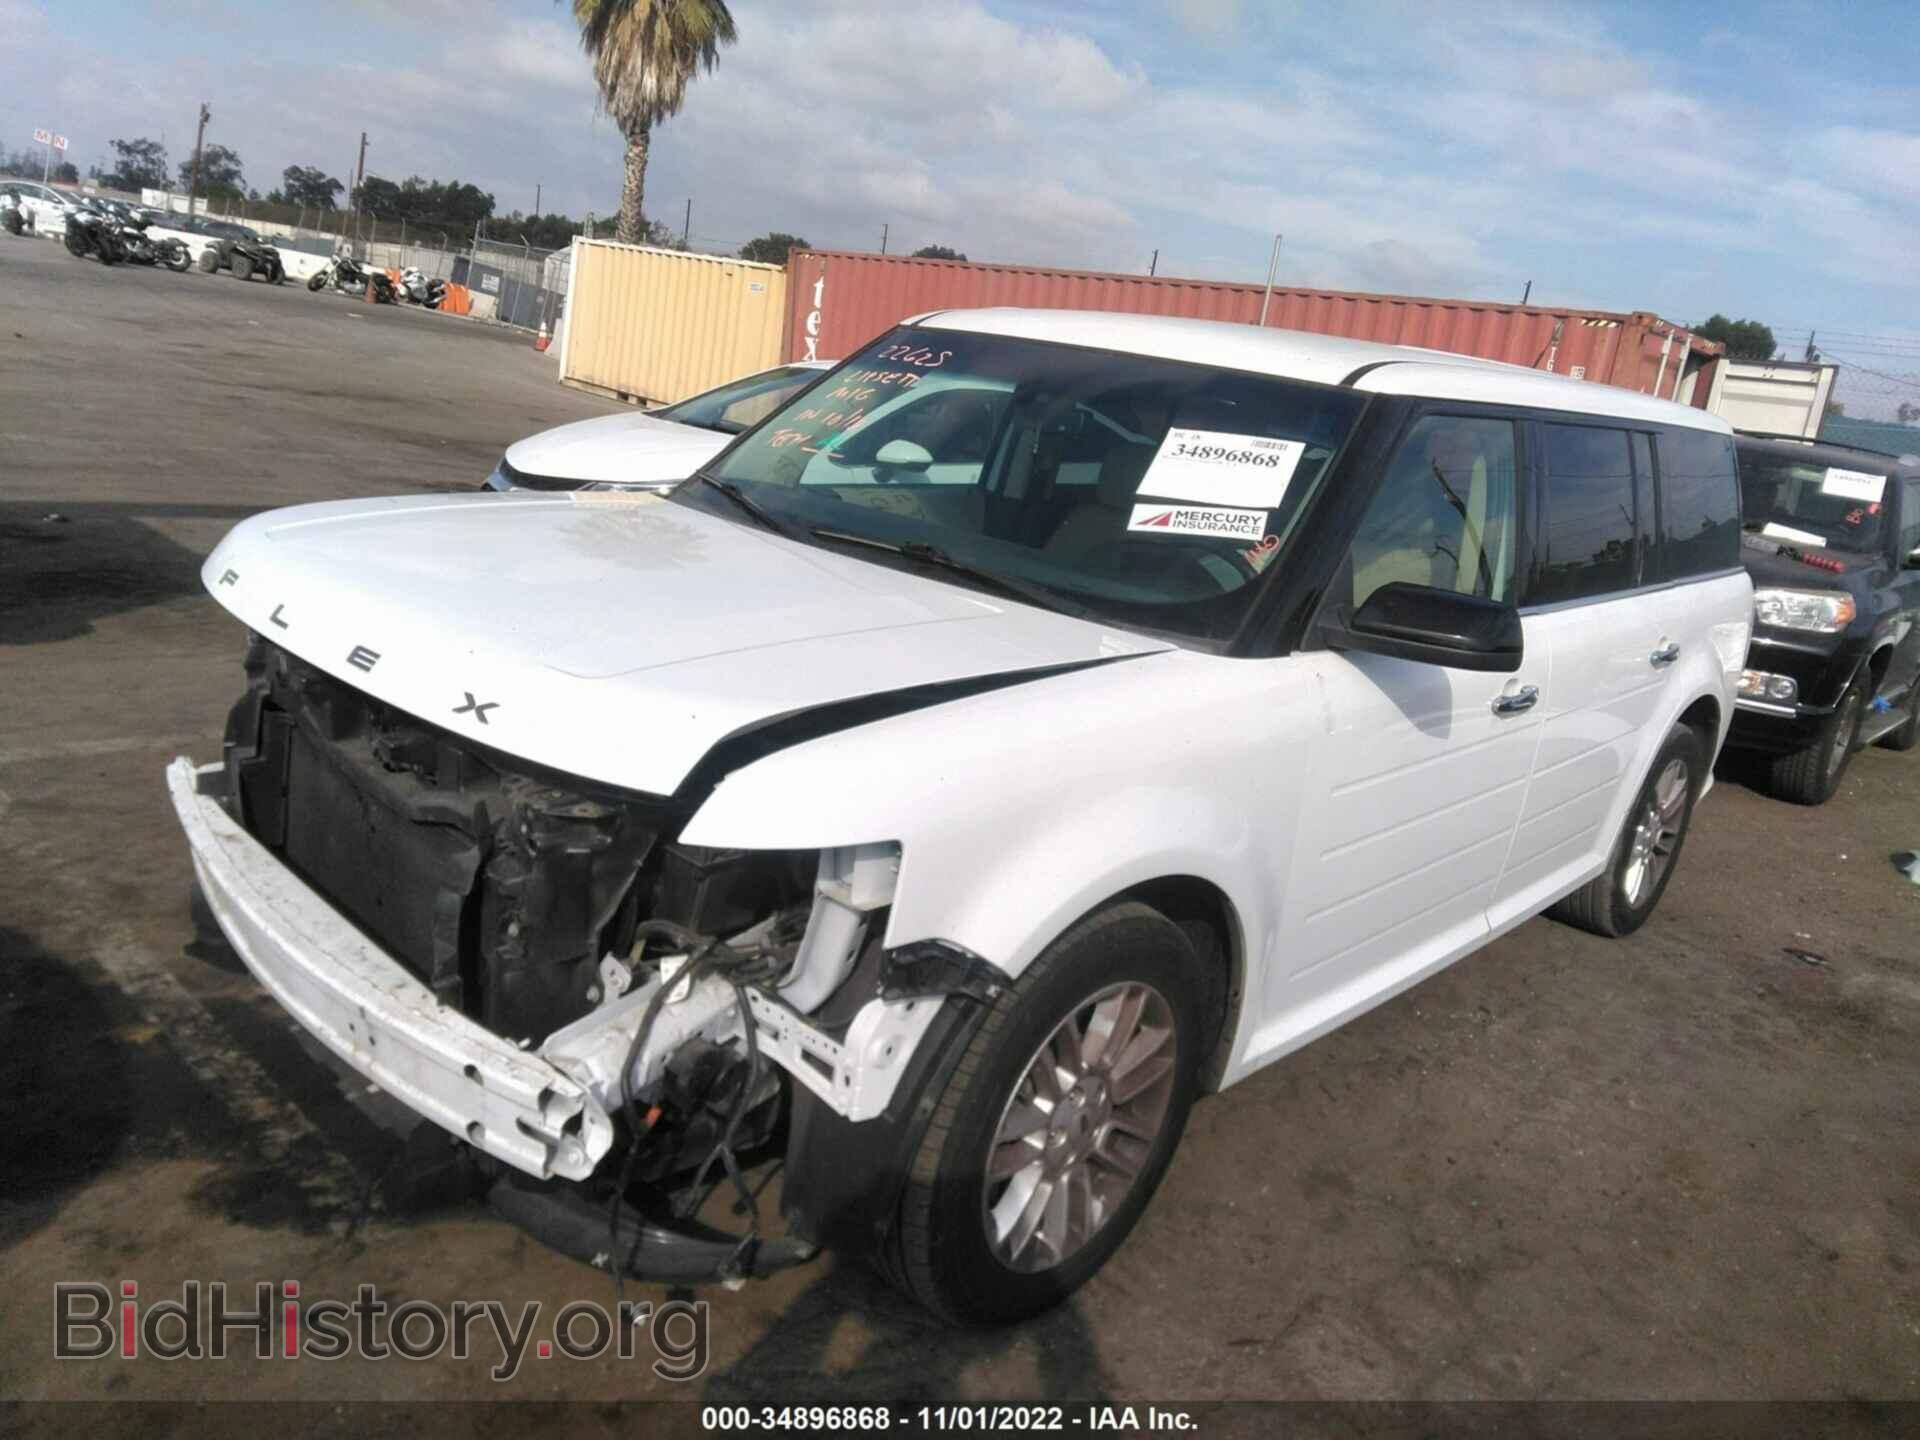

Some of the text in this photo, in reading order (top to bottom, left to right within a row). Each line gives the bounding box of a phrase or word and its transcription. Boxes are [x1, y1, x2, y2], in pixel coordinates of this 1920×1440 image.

[1171, 443, 1280, 468] 34896868
[1172, 519, 1262, 535] INSURANCE
[1174, 510, 1263, 526] MERCURY
[218, 568, 501, 725] FLEX
